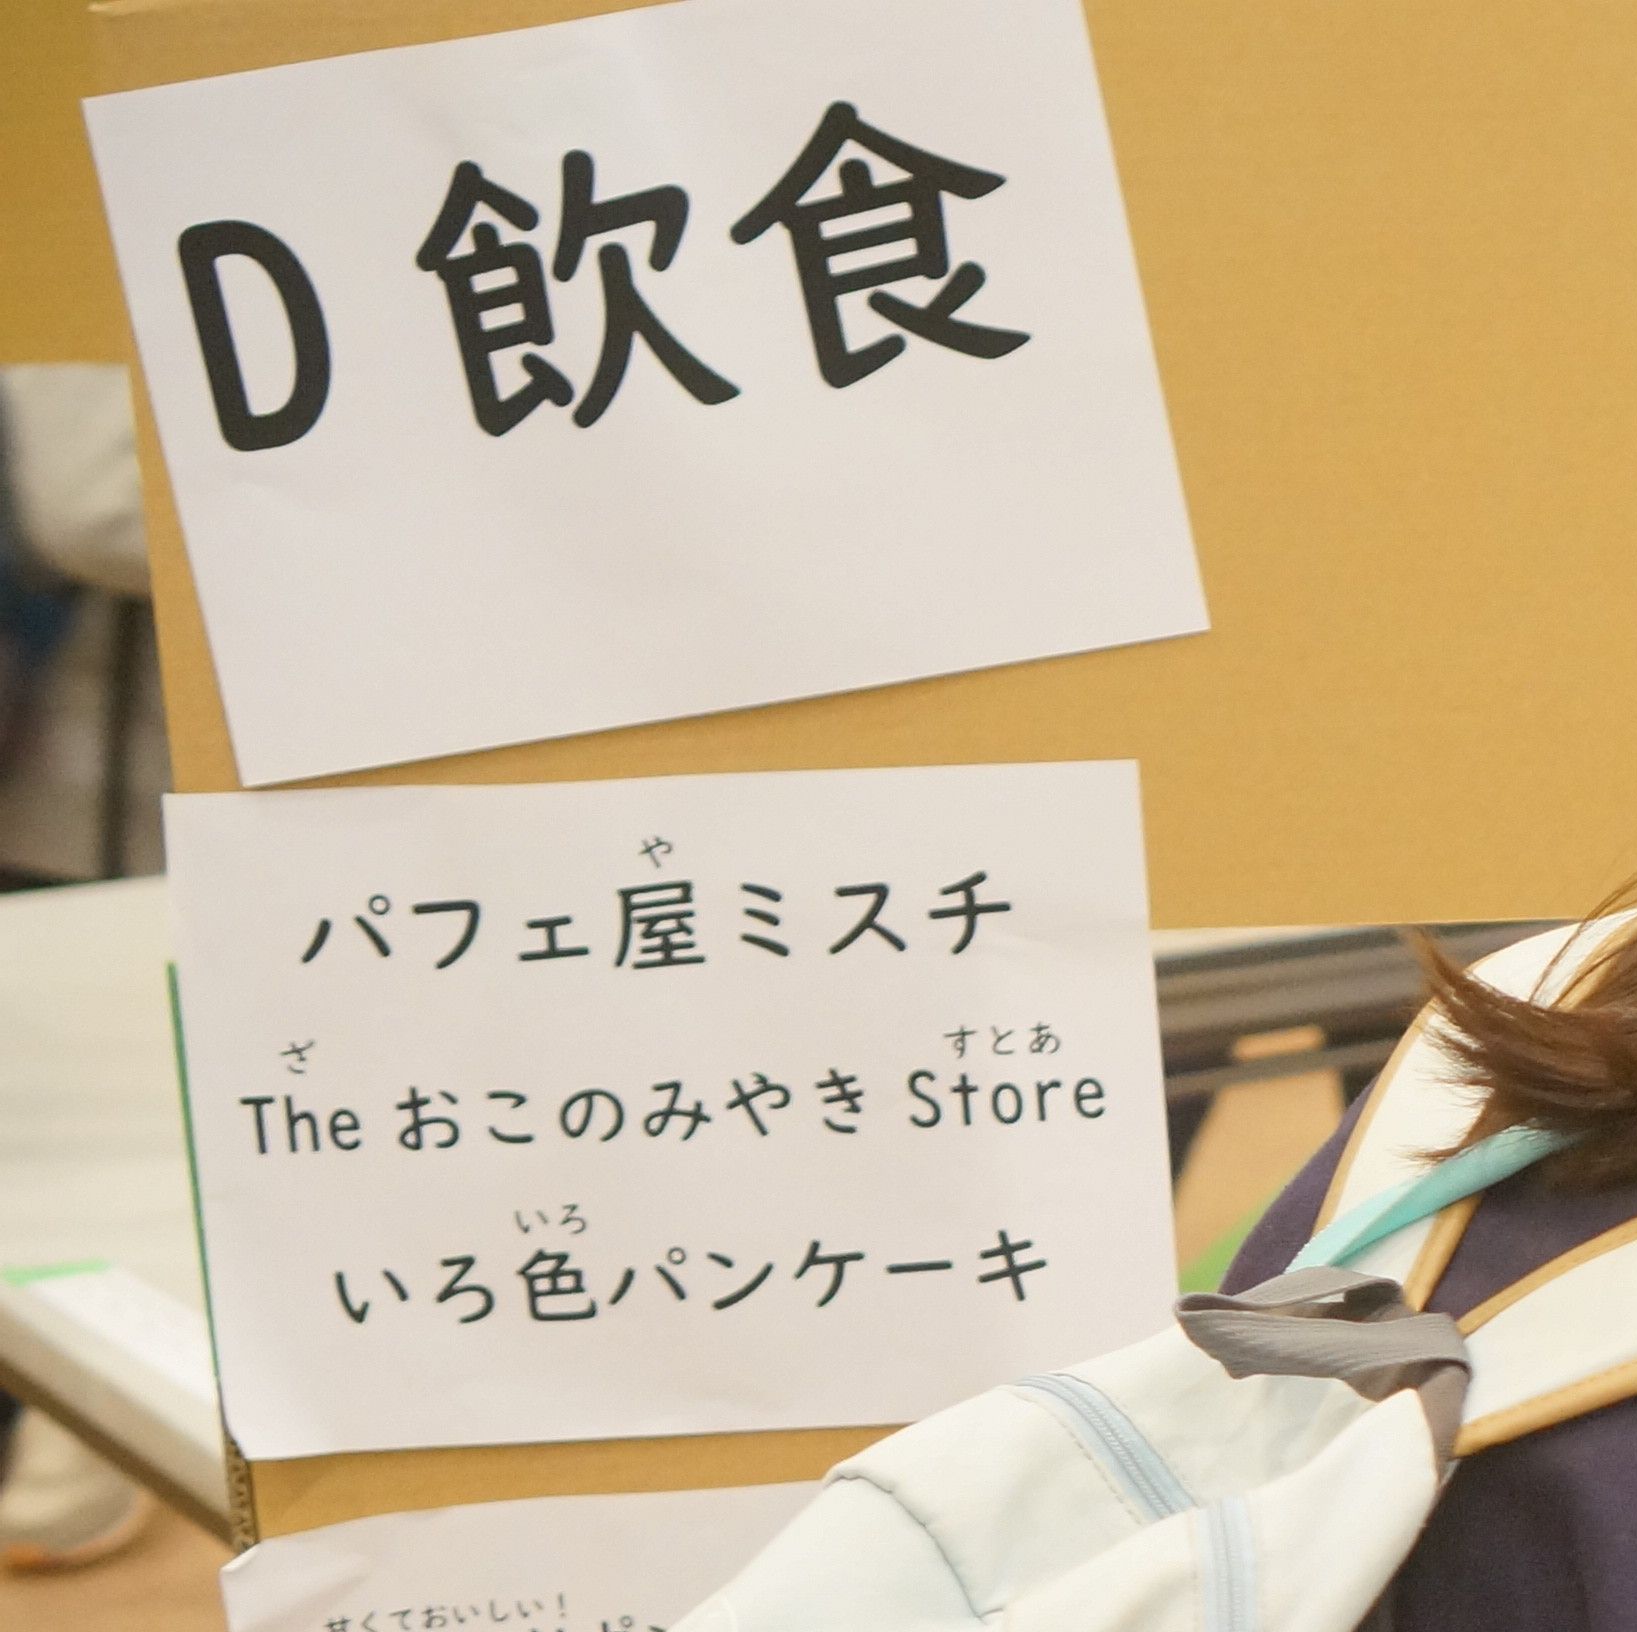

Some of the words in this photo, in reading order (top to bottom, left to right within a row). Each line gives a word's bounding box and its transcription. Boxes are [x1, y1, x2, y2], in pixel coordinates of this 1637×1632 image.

[176, 219, 332, 453] D
[414, 100, 1032, 438] 飲食
[640, 836, 673, 869] や
[300, 870, 1012, 971] パフェ屋ミスチ
[280, 1041, 314, 1075] ざ
[944, 1023, 1061, 1059] すとあ
[239, 1094, 362, 1156] The
[395, 1068, 865, 1152] おこのみやき
[907, 1069, 1106, 1129] Store
[515, 1203, 587, 1235] いろ
[334, 1229, 1048, 1325] いろ色パンケーキ
